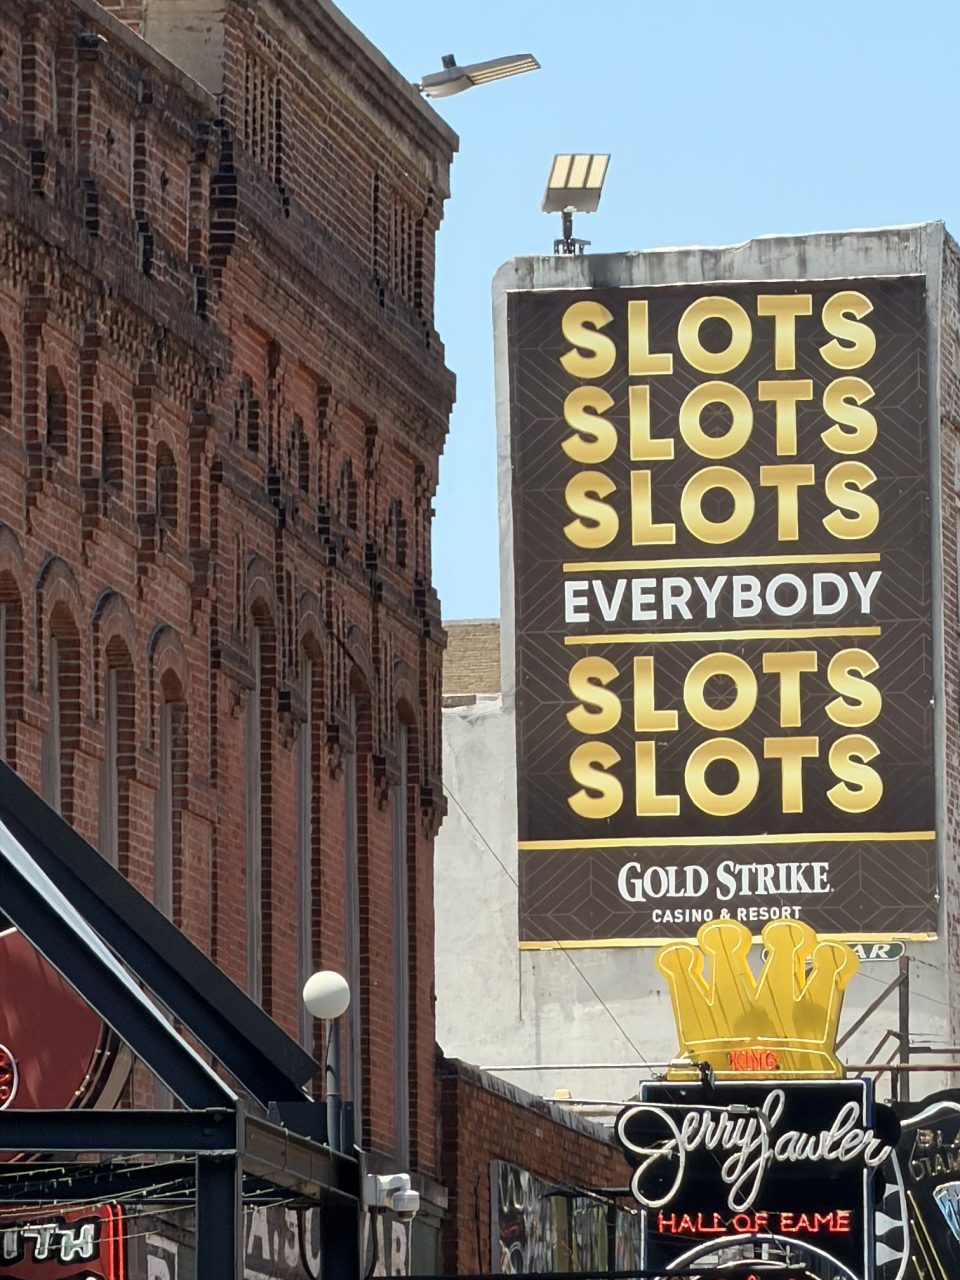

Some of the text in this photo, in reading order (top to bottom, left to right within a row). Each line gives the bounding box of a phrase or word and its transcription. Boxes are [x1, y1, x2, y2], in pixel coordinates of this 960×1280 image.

[559, 290, 878, 379] SLOTS
[561, 376, 880, 464] SLOTS
[562, 461, 881, 549] SLOTS
[564, 571, 882, 623] EVERYBODY
[565, 648, 883, 735] SLOTS
[567, 734, 884, 820] SLOTS
[617, 860, 831, 902] GOLD STRIKE
[652, 906, 802, 923] CASINO & RESORT
[731, 1050, 778, 1071] KING
[617, 1089, 892, 1212] Jerry Lawler
[3, 1223, 95, 1261] ITH
[657, 1210, 726, 1233] HALL
[732, 1213, 768, 1233] OF
